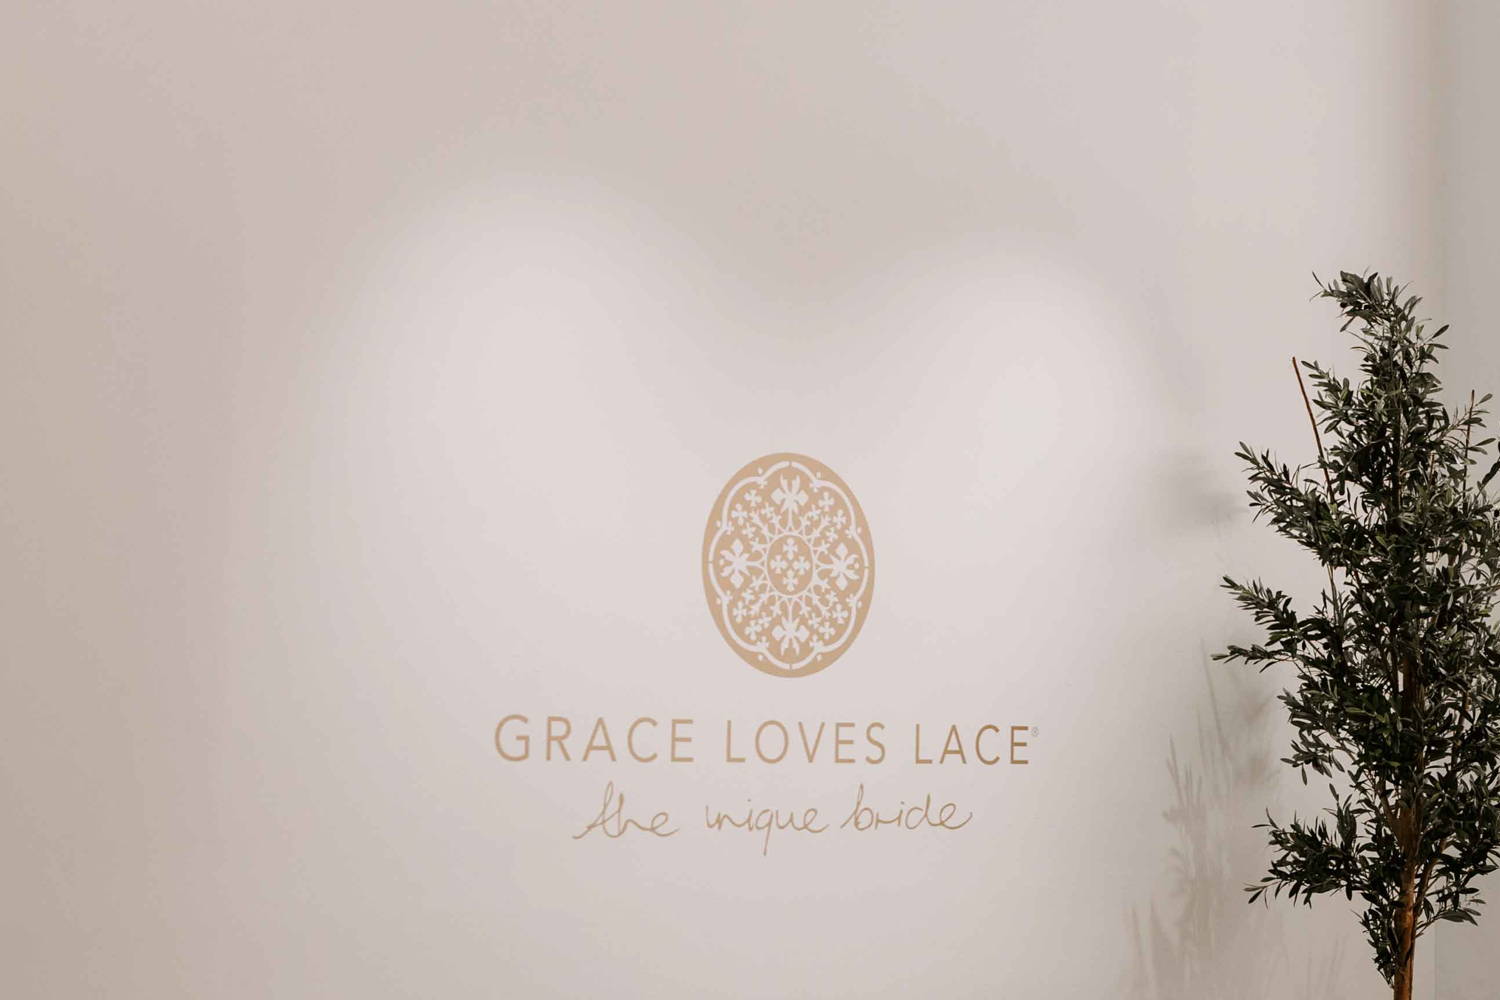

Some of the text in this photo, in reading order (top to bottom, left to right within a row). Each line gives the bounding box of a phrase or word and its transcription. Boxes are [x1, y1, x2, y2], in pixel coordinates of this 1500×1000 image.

[494, 714, 694, 763] GRACE
[725, 719, 886, 764] LOVES
[572, 780, 680, 840] the
[839, 783, 973, 831] bride
